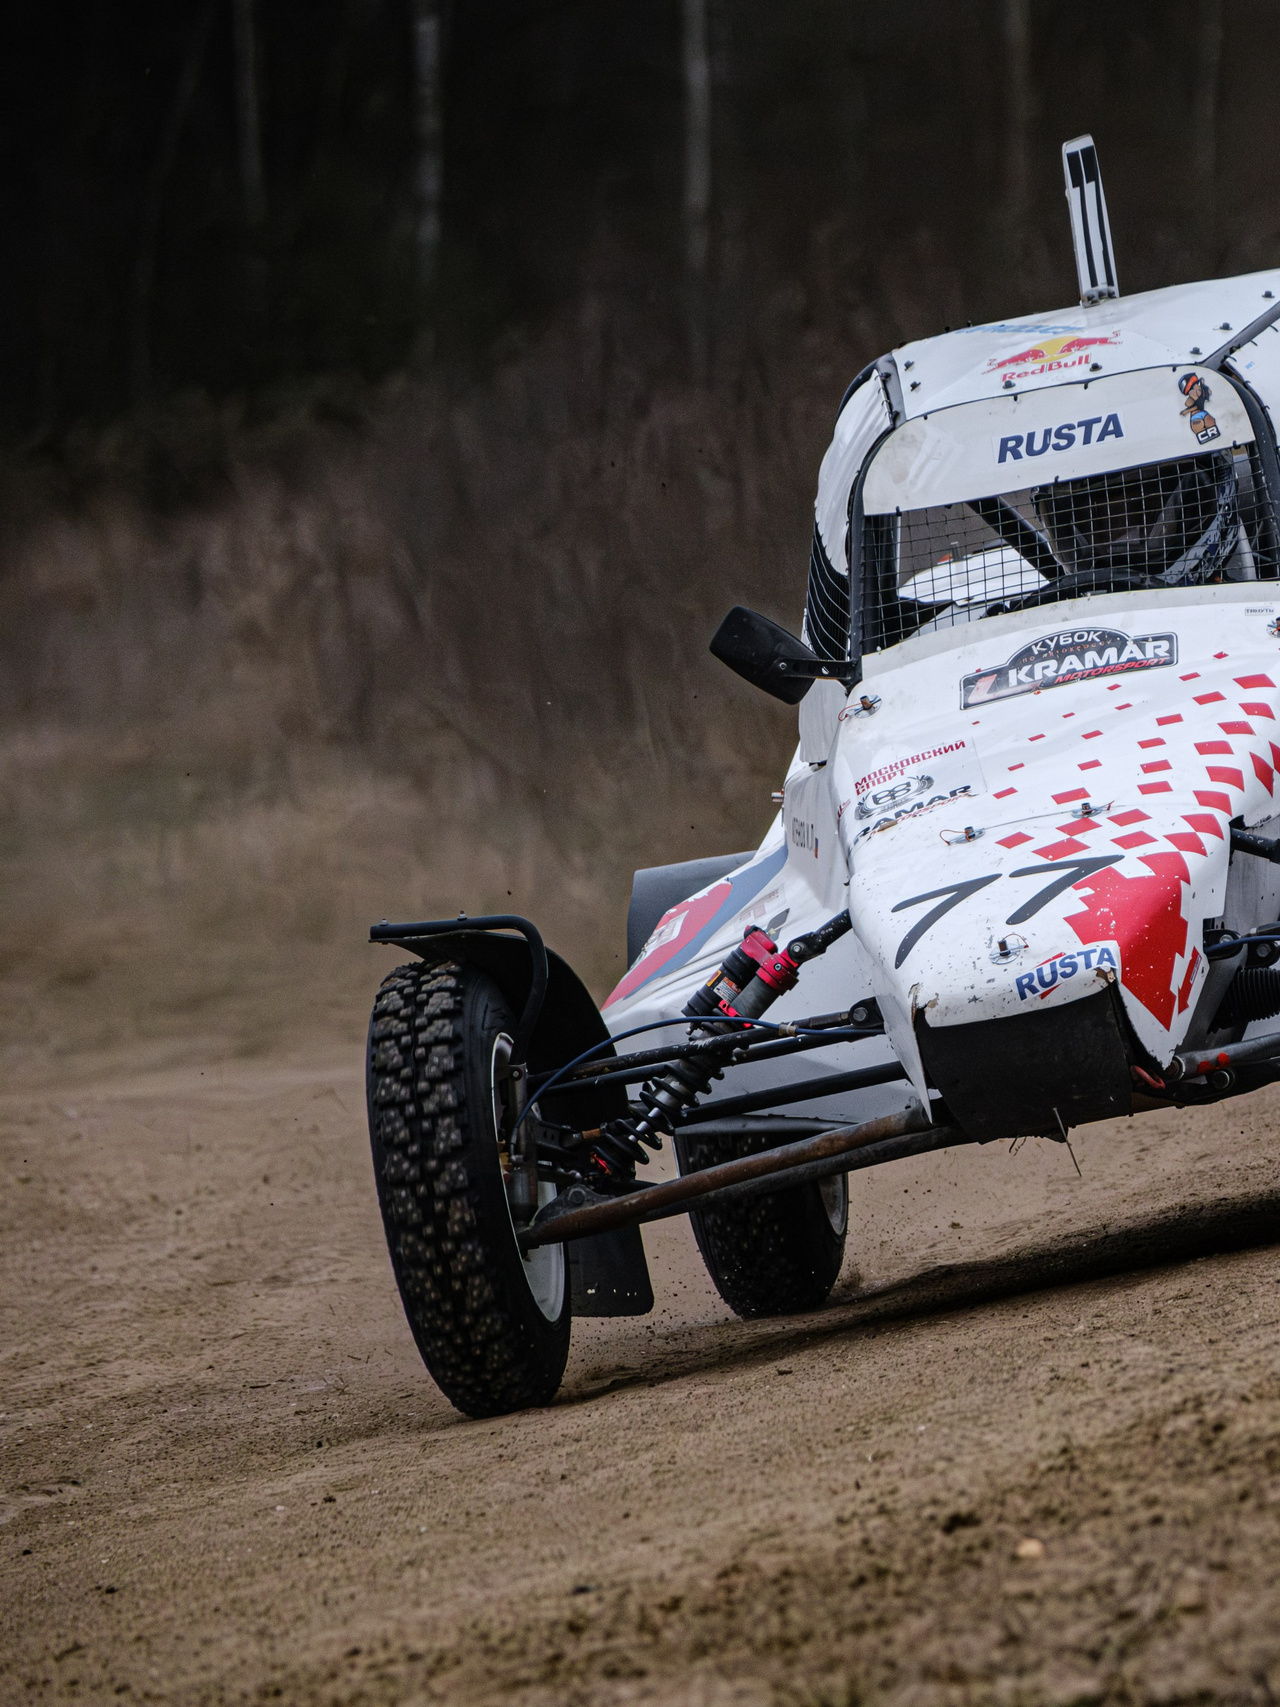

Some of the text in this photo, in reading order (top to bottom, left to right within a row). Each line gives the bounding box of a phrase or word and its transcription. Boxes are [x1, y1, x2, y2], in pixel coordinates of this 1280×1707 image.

[1001, 354, 1093, 383] Red Bull
[997, 412, 1125, 464] RUSTA
[1008, 638, 1171, 688] KRAMAR
[1031, 630, 1103, 655] КУБОК
[1053, 656, 1170, 685] MOTORSPORT
[854, 740, 966, 790] МОСКОВСКИЙ
[856, 767, 907, 796] СПОРТ
[891, 854, 1126, 970] 77
[1015, 947, 1117, 1001] RUSTA
